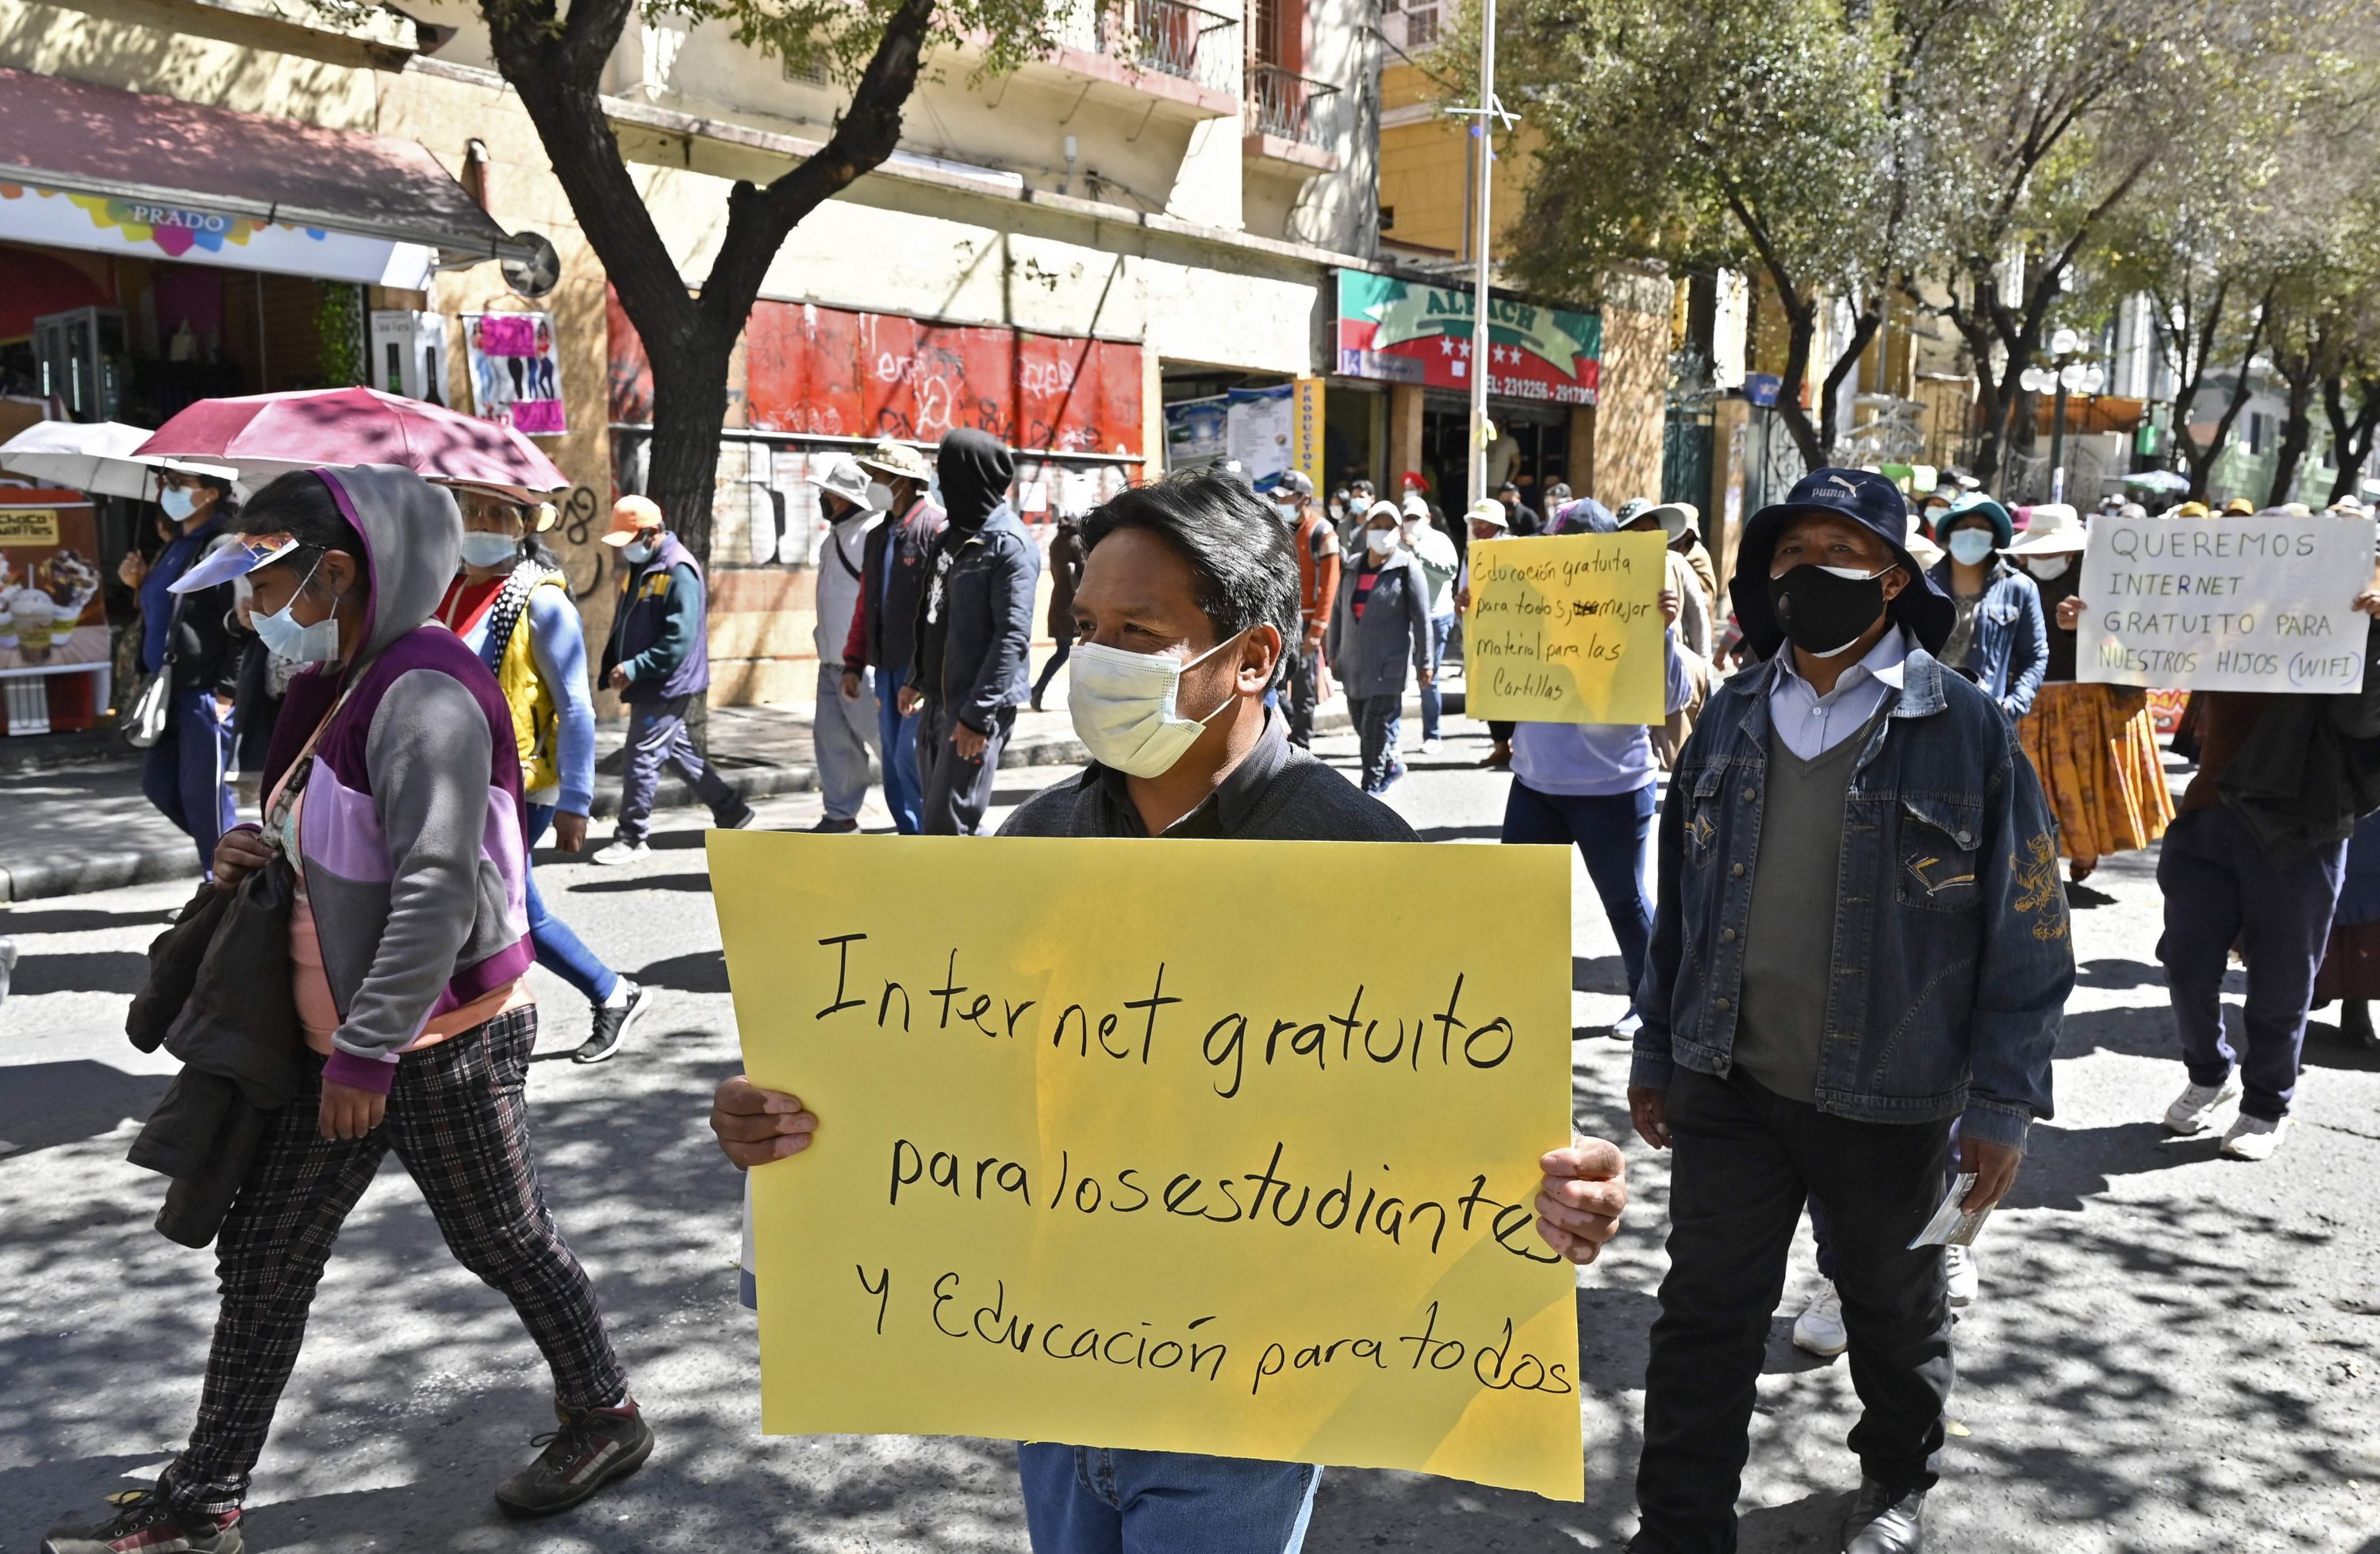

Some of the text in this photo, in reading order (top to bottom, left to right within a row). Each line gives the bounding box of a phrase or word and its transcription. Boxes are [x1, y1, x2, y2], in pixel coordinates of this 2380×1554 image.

[133, 205, 225, 232] PRADO
[1488, 374, 1502, 394] EL:
[1302, 385, 1313, 470] PRODUCTOS
[2111, 528, 2316, 562] QUEREMOS
[1562, 547, 1631, 587] gratuita
[2108, 572, 2244, 597] INTERNET
[1475, 597, 1509, 620] para
[2103, 611, 2332, 637] GRATUITO PARA
[1545, 644, 1580, 663] para
[1588, 632, 1622, 662] las
[2098, 644, 2363, 688] NUESTROS HIJOS (WIFI)
[815, 933, 1514, 1099] Internet gratuito
[890, 1138, 1031, 1207] para
[1050, 1150, 1150, 1214] los
[932, 1272, 1226, 1382] Educación
[1251, 1338, 1388, 1396] para
[1399, 1300, 1573, 1395] todos
